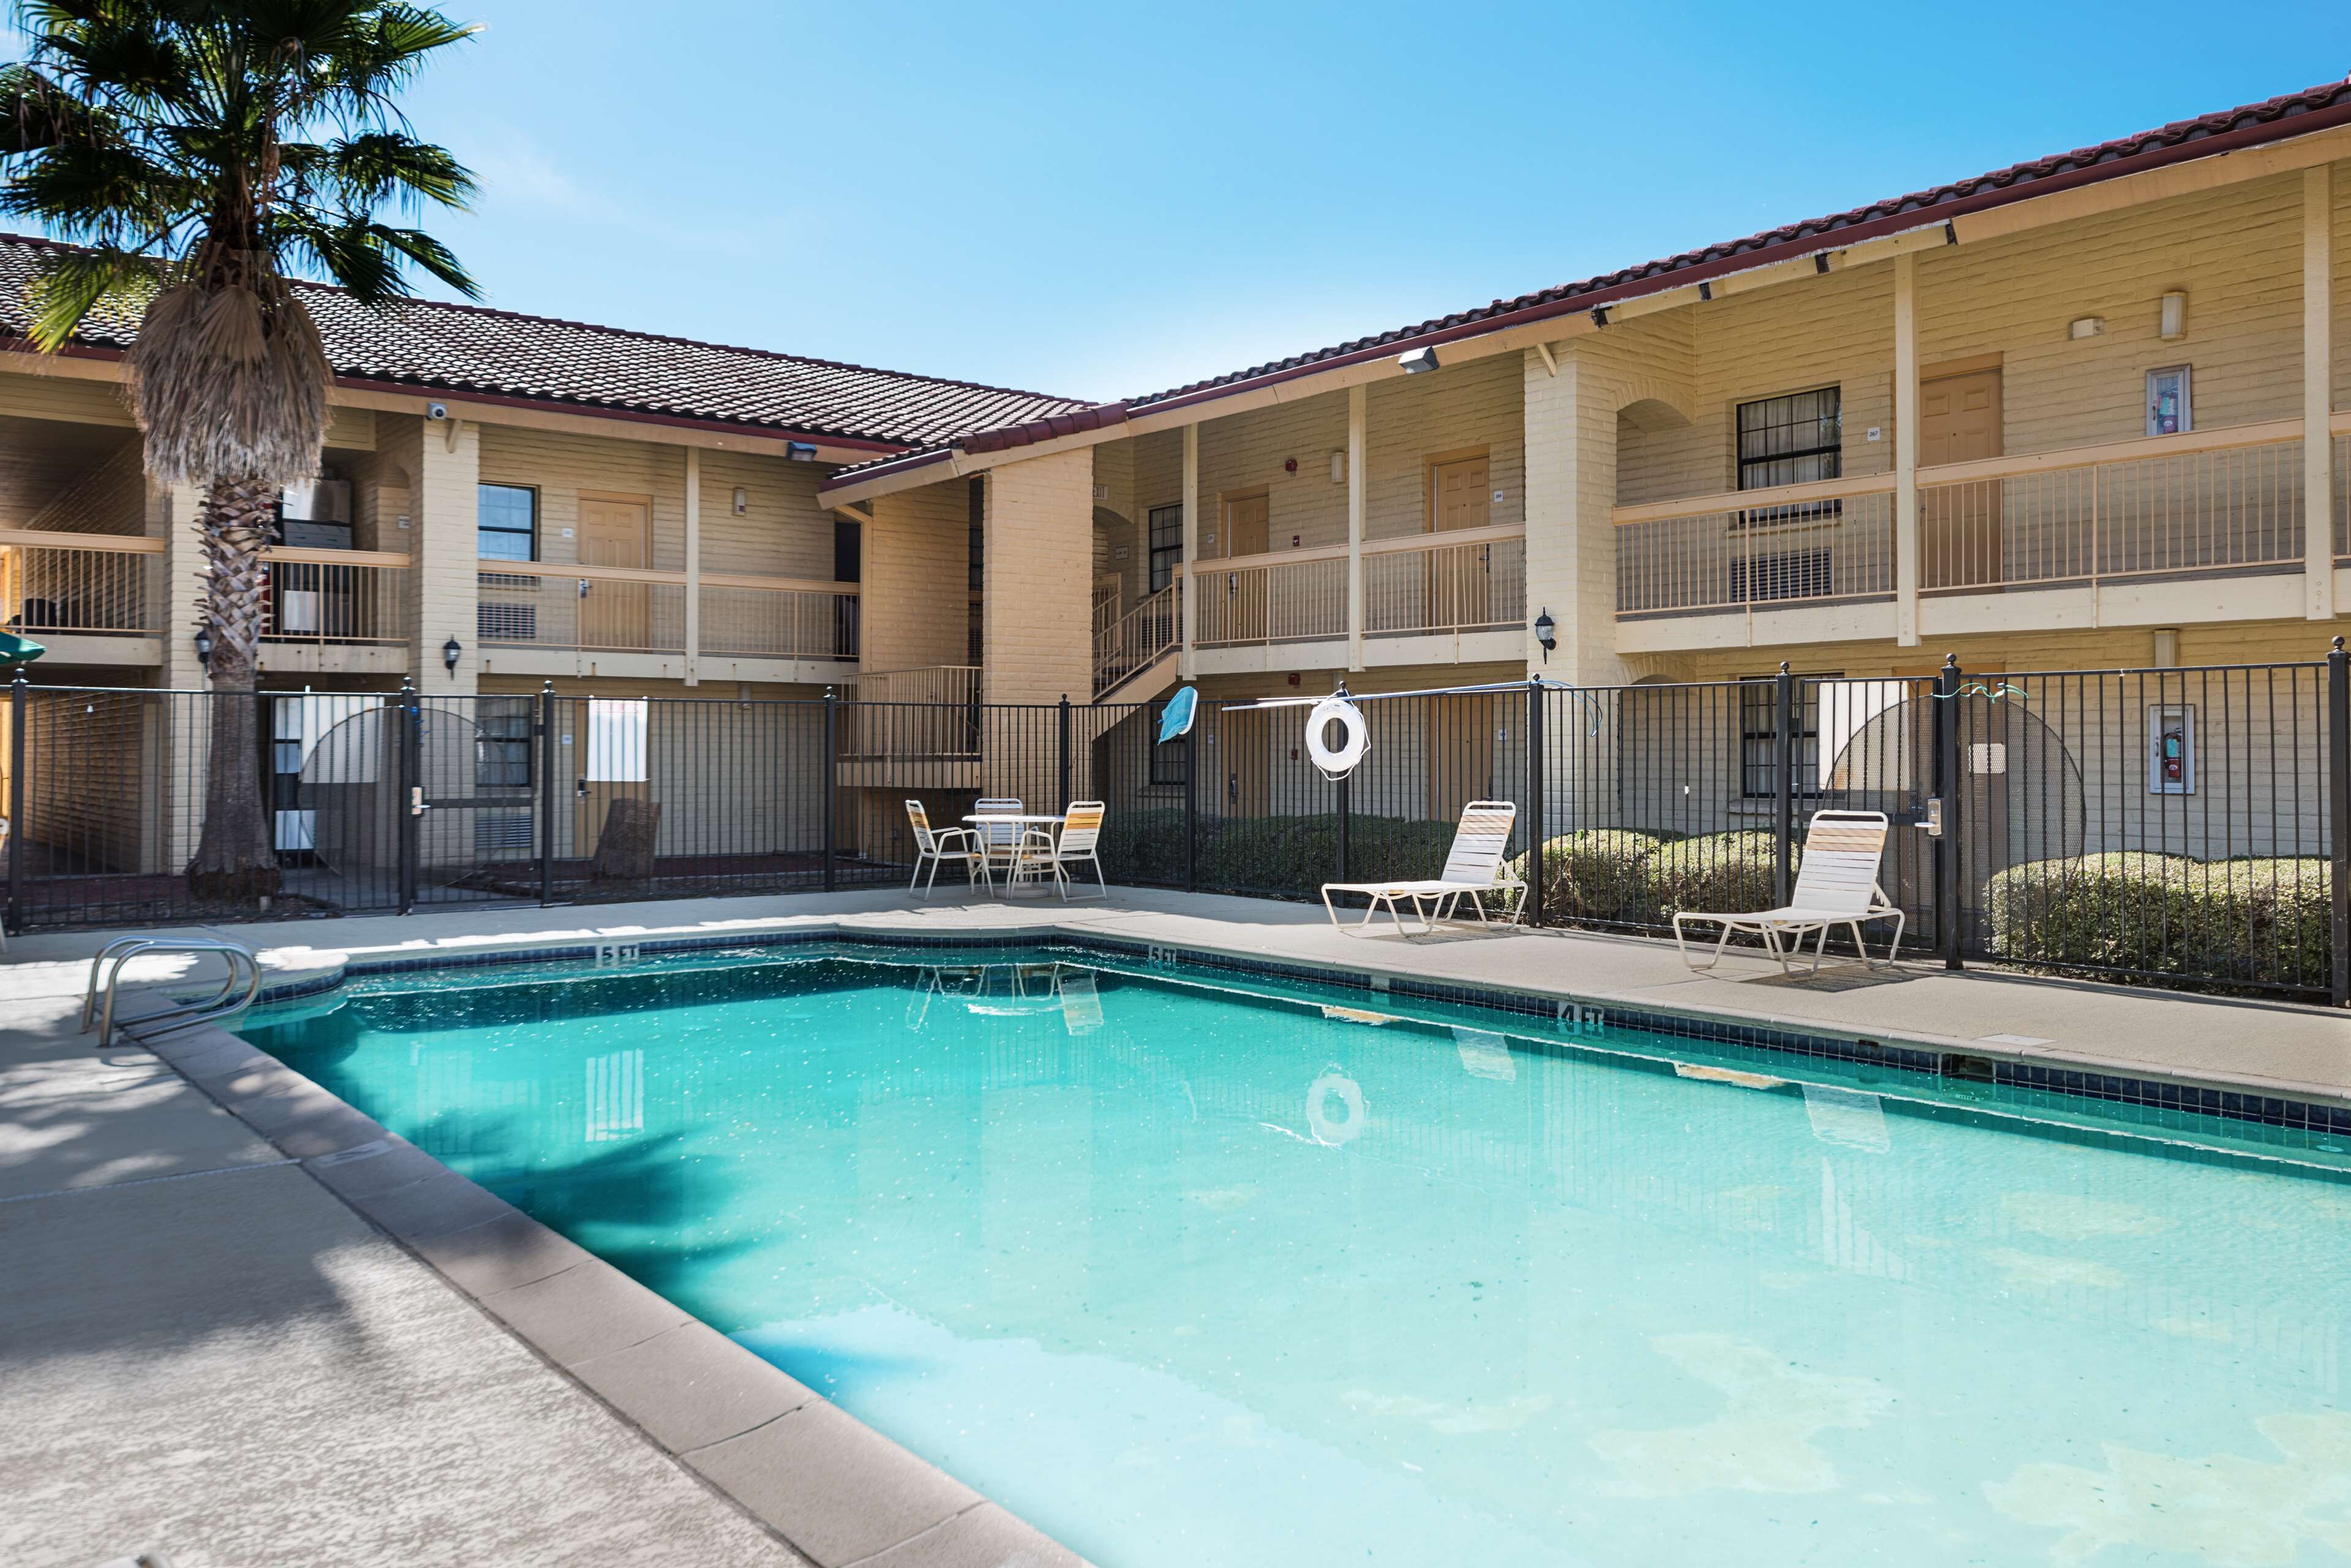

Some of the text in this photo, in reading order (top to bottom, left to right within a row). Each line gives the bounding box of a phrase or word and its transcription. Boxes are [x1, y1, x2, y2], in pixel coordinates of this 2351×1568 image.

[1093, 486, 1105, 498] EXIT
[602, 945, 638, 958] 5 FT
[1152, 947, 1175, 962] 5 FT
[1561, 1004, 1603, 1024] 4 FT
